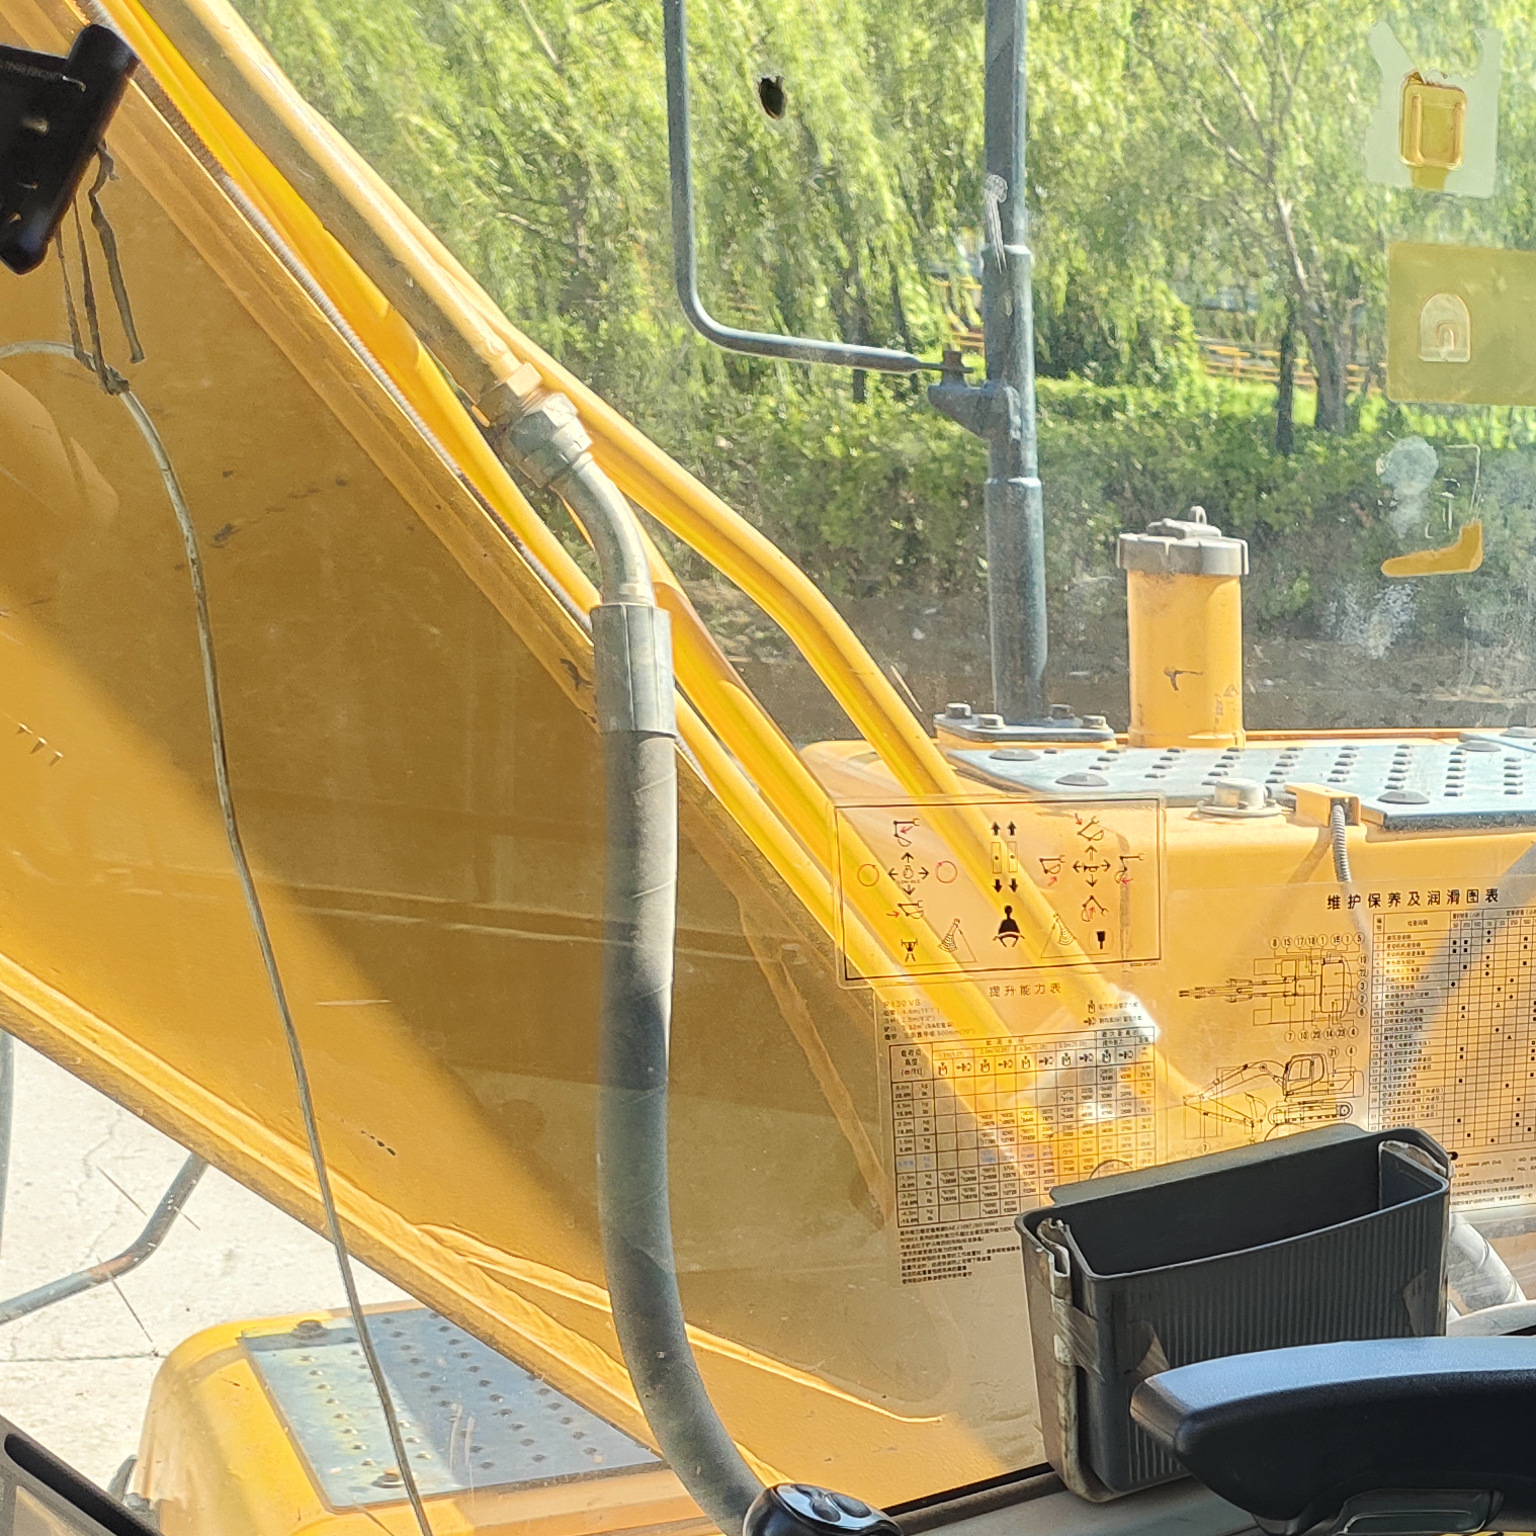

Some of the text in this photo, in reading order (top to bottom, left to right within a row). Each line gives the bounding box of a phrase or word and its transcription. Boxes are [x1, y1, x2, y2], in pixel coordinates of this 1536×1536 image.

[1327, 888, 1498, 910] 维护保养及润滑图表
